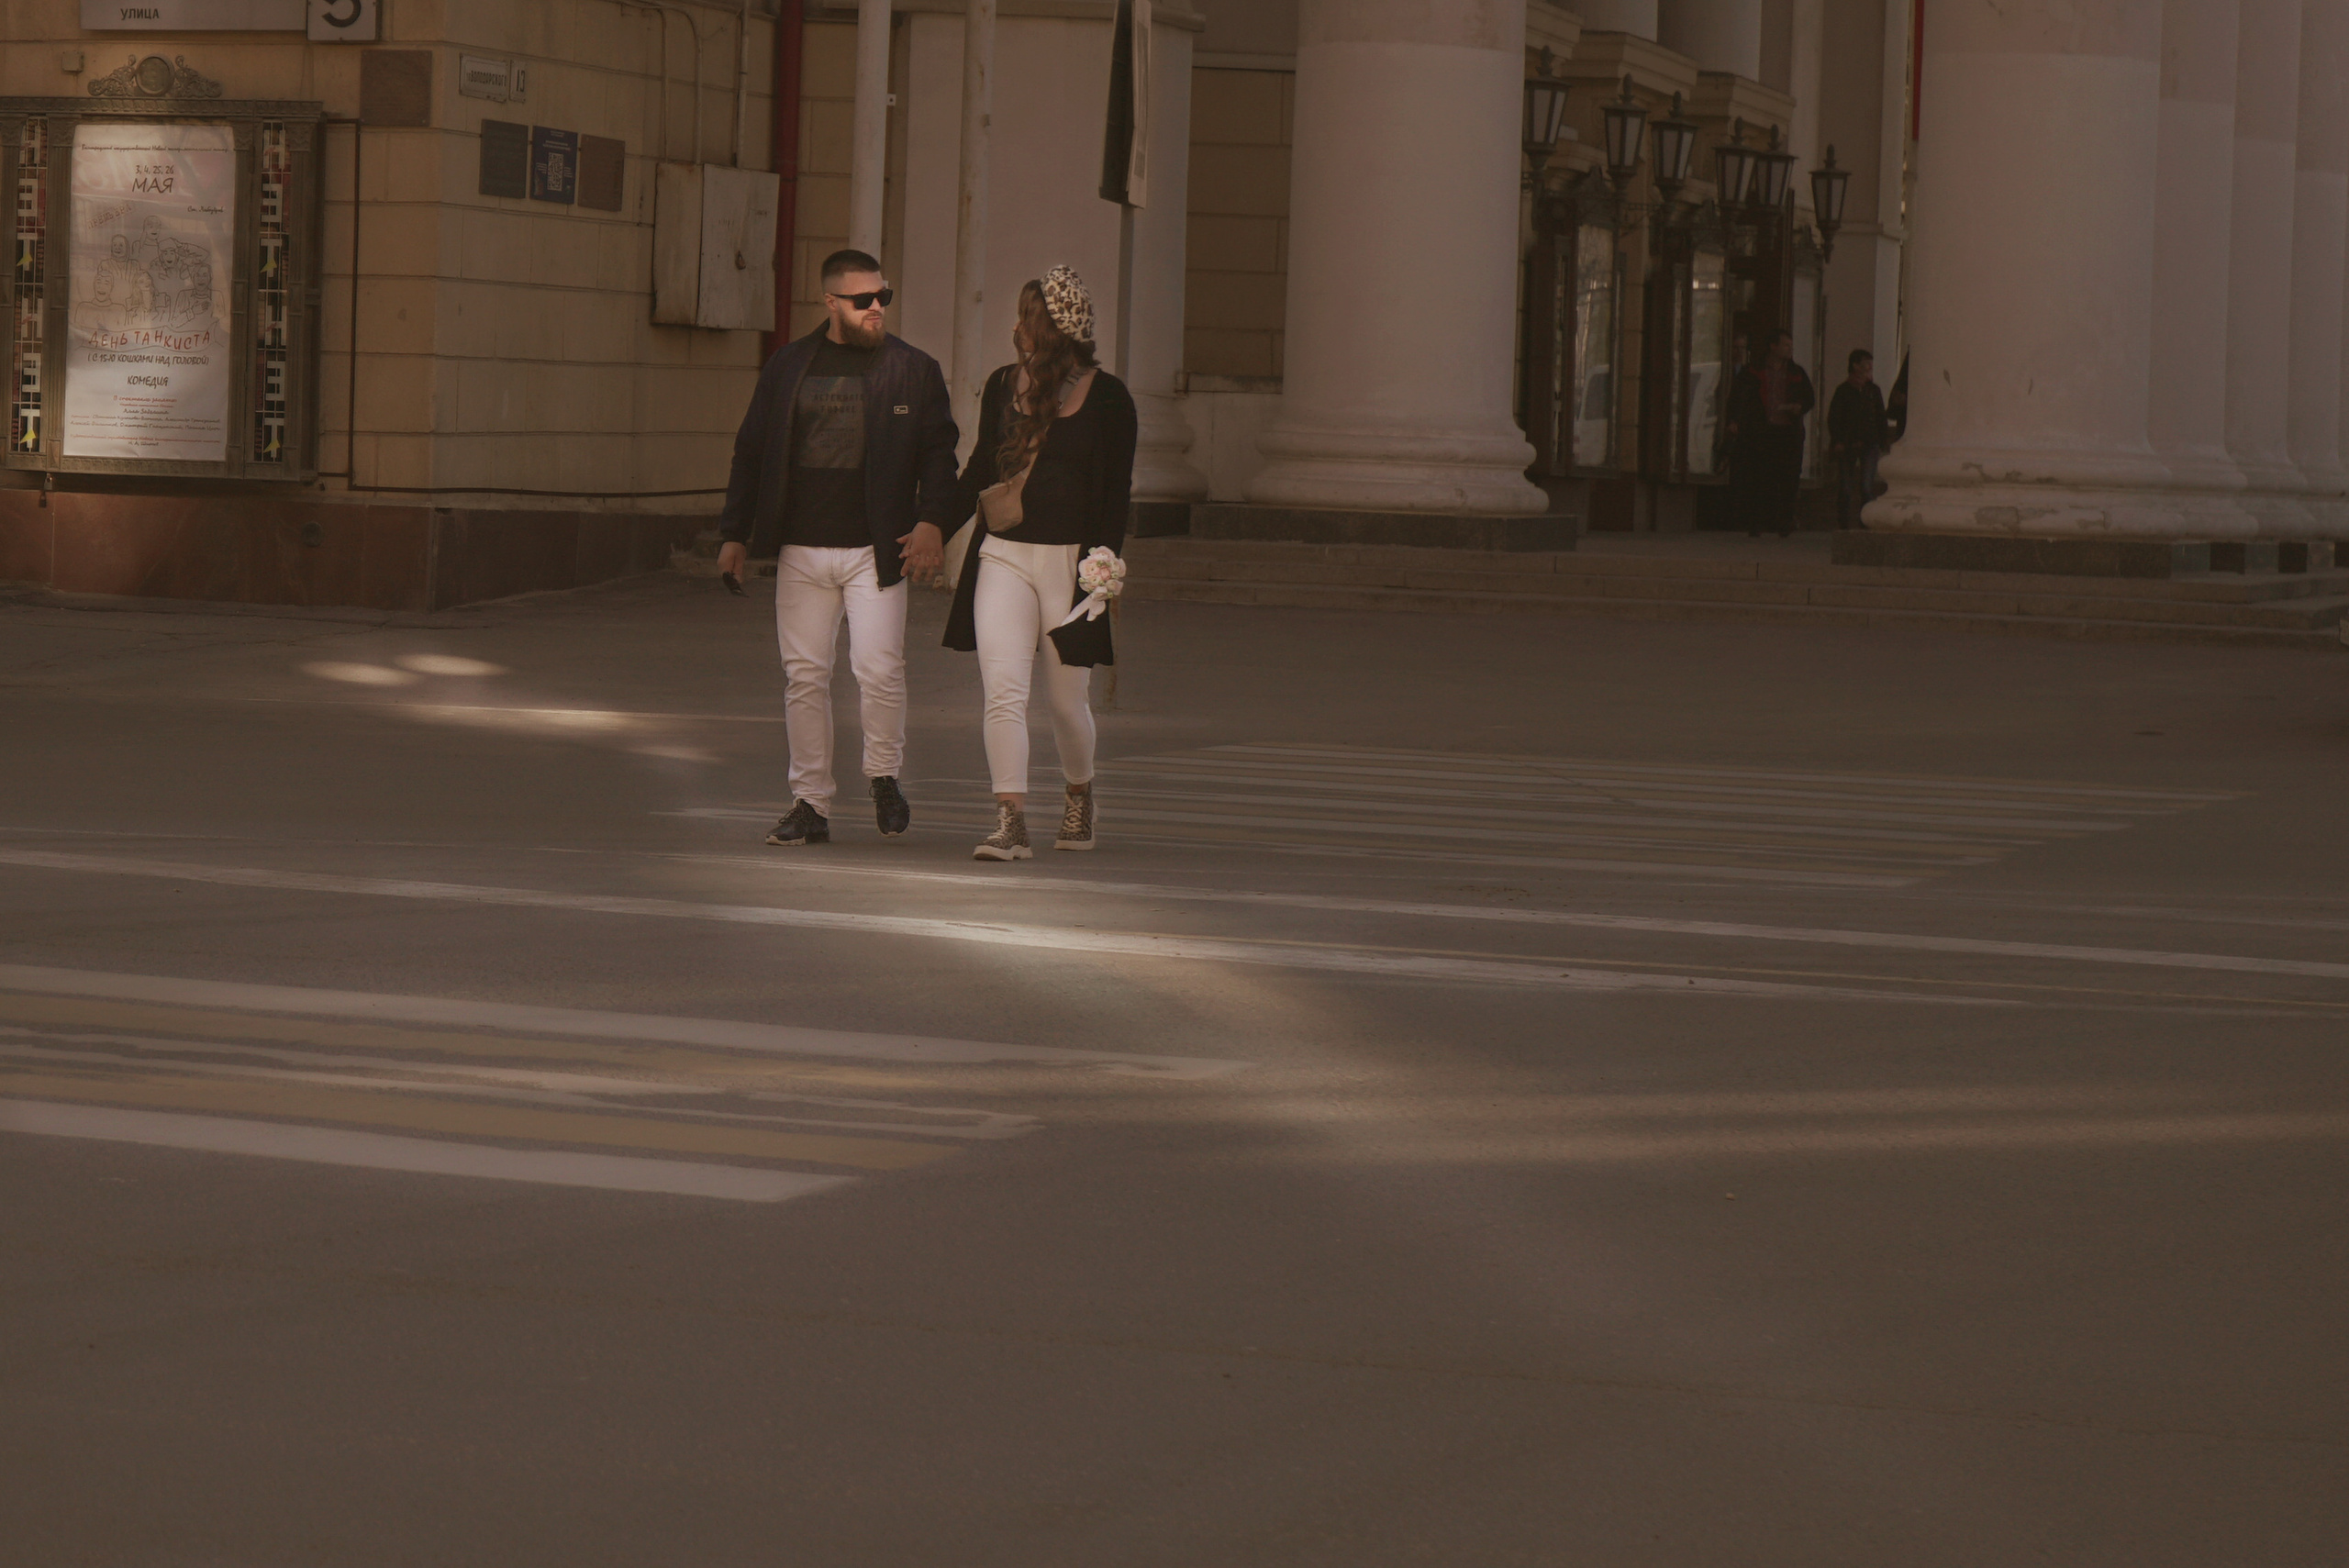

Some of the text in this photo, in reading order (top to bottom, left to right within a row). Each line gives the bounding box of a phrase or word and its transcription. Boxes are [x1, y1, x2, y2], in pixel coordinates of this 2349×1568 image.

[119, 7, 160, 21] УЛИЦА
[516, 69, 526, 93] 13
[135, 164, 174, 175] 3, 4, 25, 26
[131, 177, 174, 194] МАЯ
[88, 329, 211, 350] ДЕНЬ ТАНКИСТА
[117, 354, 154, 364] КОШКАМИ
[155, 355, 172, 367] НАД
[172, 355, 210, 366] ГОЛОВОЙ)
[127, 374, 169, 390] КОМЕДИЯ
